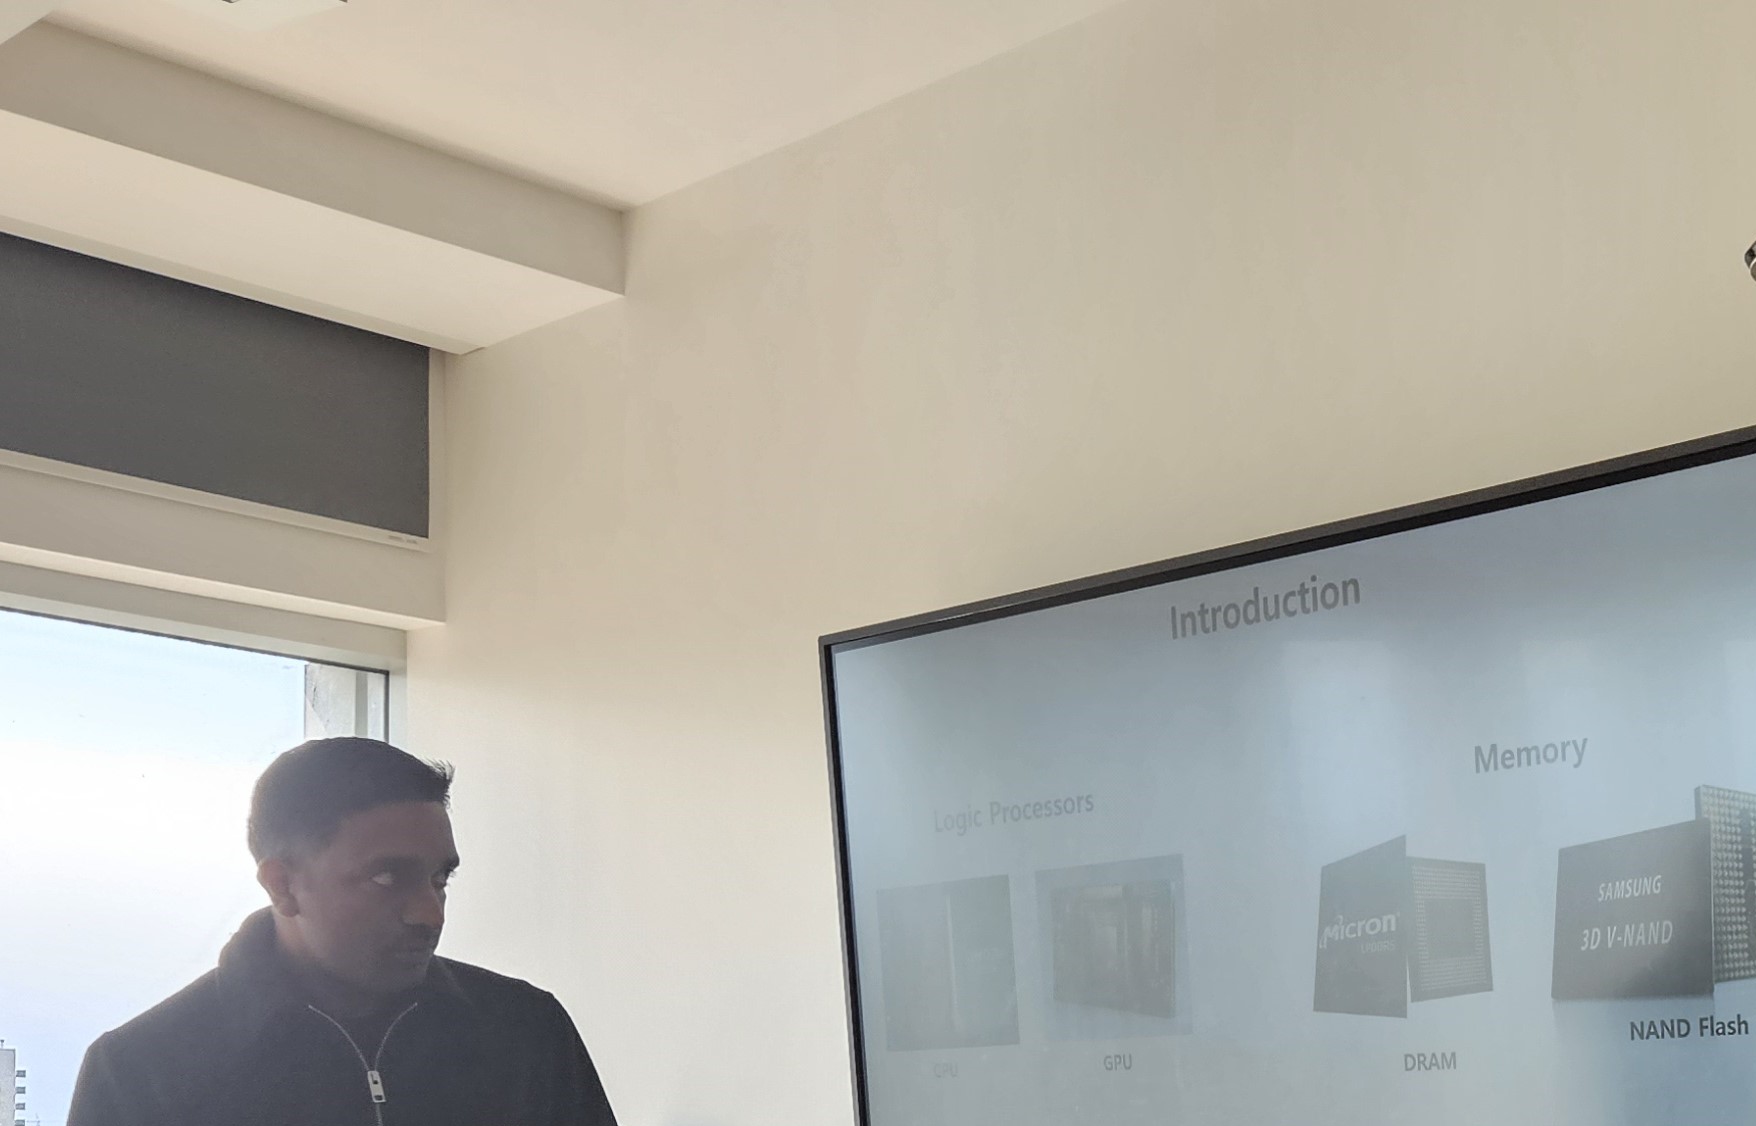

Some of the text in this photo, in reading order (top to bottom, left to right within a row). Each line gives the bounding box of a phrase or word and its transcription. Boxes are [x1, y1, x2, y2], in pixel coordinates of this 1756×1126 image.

[1170, 574, 1361, 639] Introduction
[1474, 737, 1588, 775] Memory
[934, 791, 1094, 836] Logic Processors
[1598, 875, 1662, 902] SAMSUNG
[1581, 920, 1673, 953] 3D V-NAND
[1629, 1014, 1749, 1042] NAND Flash
[1103, 1053, 1133, 1073] GPU
[1403, 1052, 1458, 1072] DRAM
